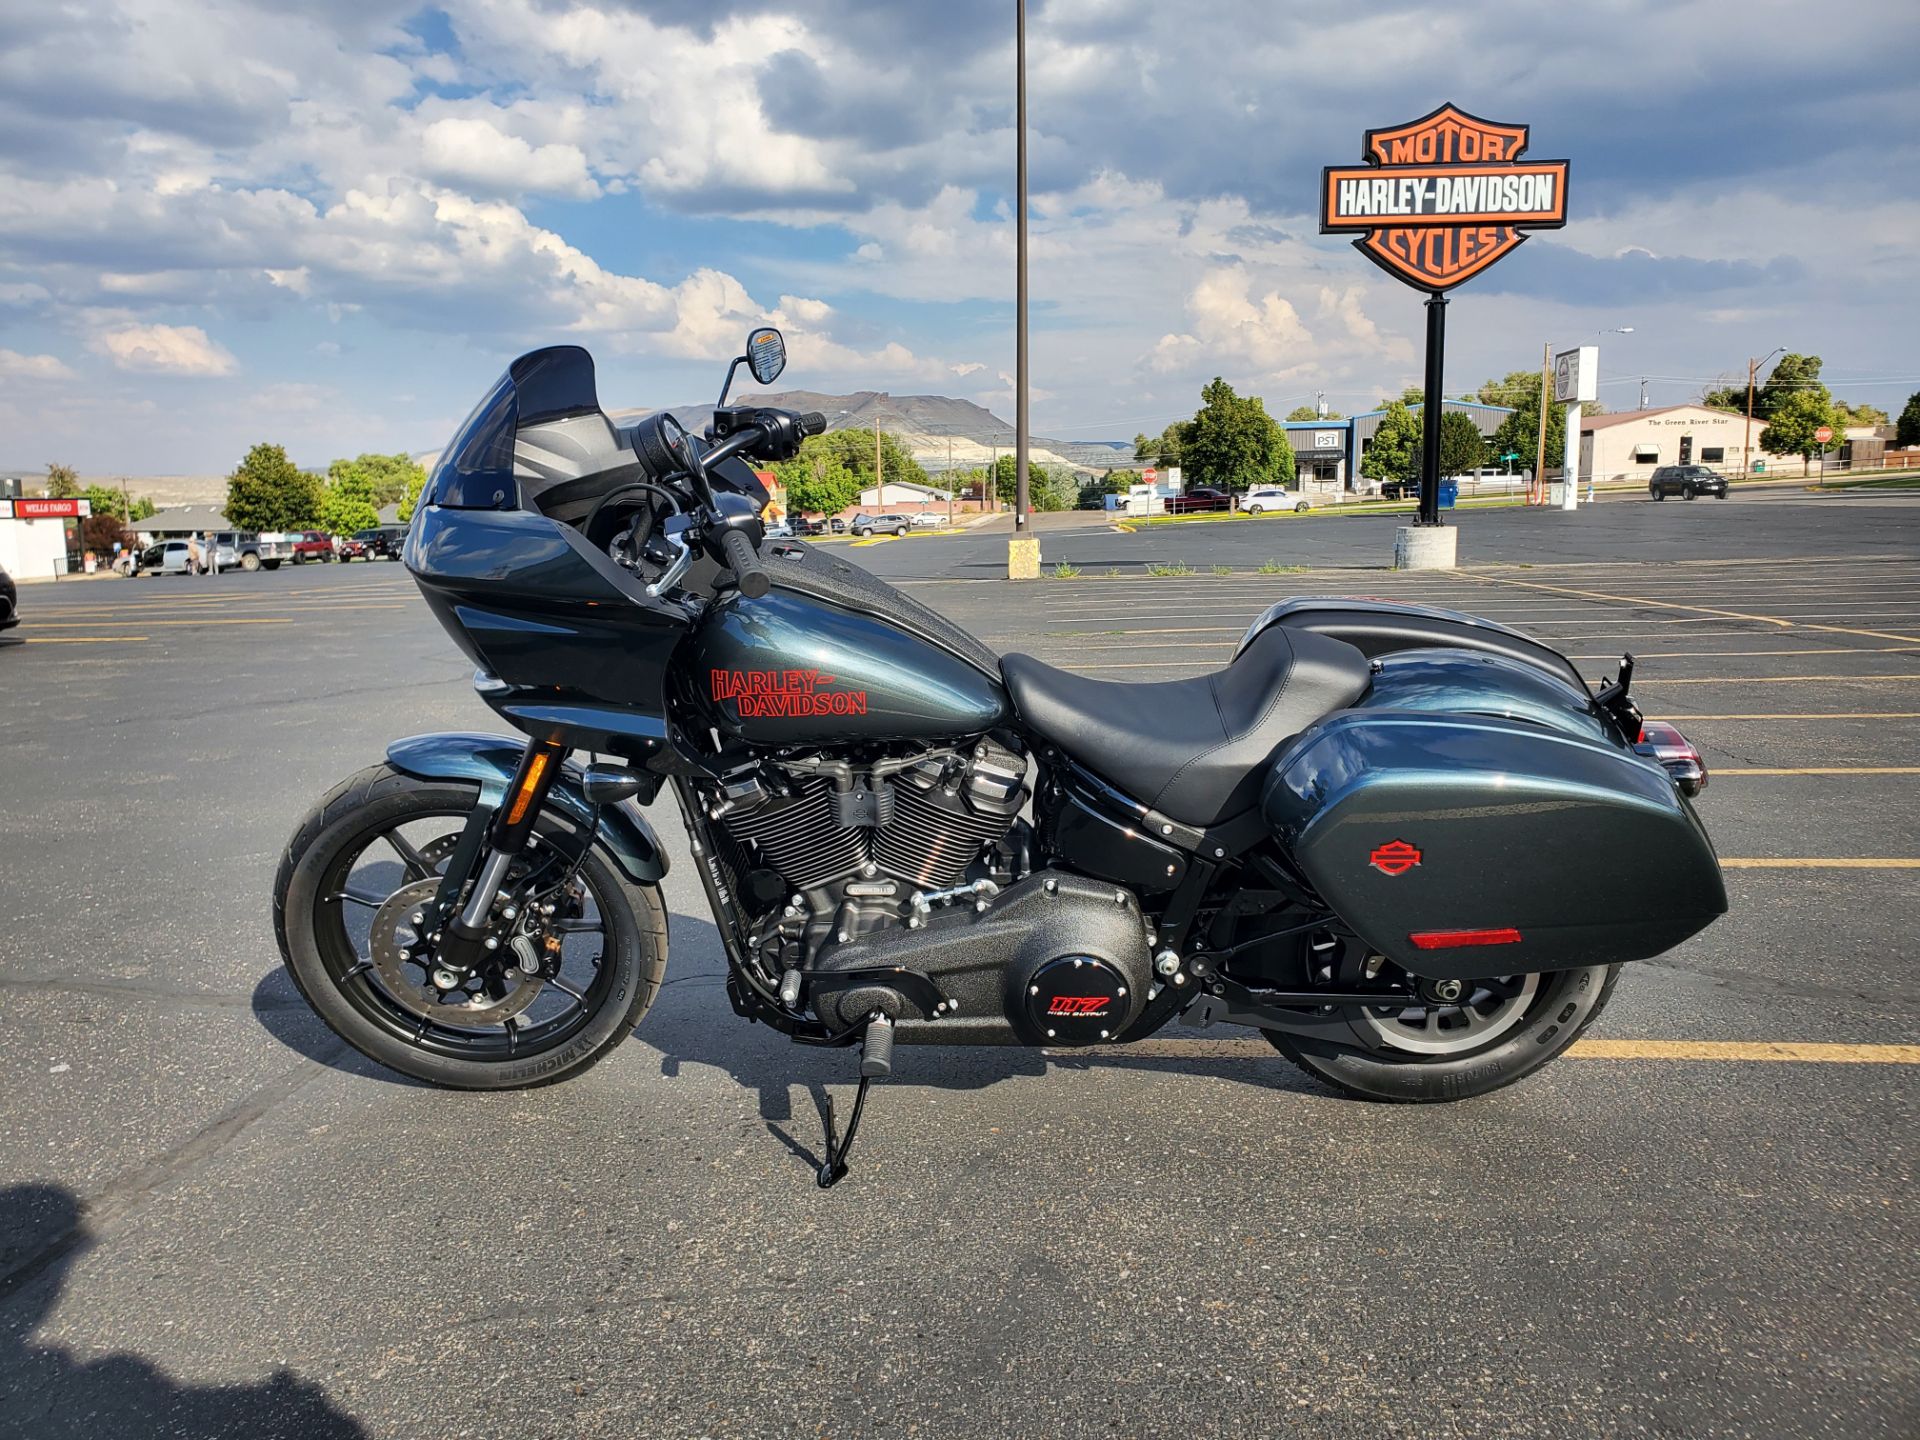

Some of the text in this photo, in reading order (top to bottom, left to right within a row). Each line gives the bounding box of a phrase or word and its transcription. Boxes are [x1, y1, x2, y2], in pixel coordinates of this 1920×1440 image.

[1391, 119, 1504, 164] MOTOR
[1339, 174, 1554, 216] HARLEY-DAVIDSON
[1388, 227, 1498, 275] CYCLES
[25, 503, 49, 513] WELLS
[50, 503, 72, 513] FARGO
[738, 691, 867, 717] DAVIDSON
